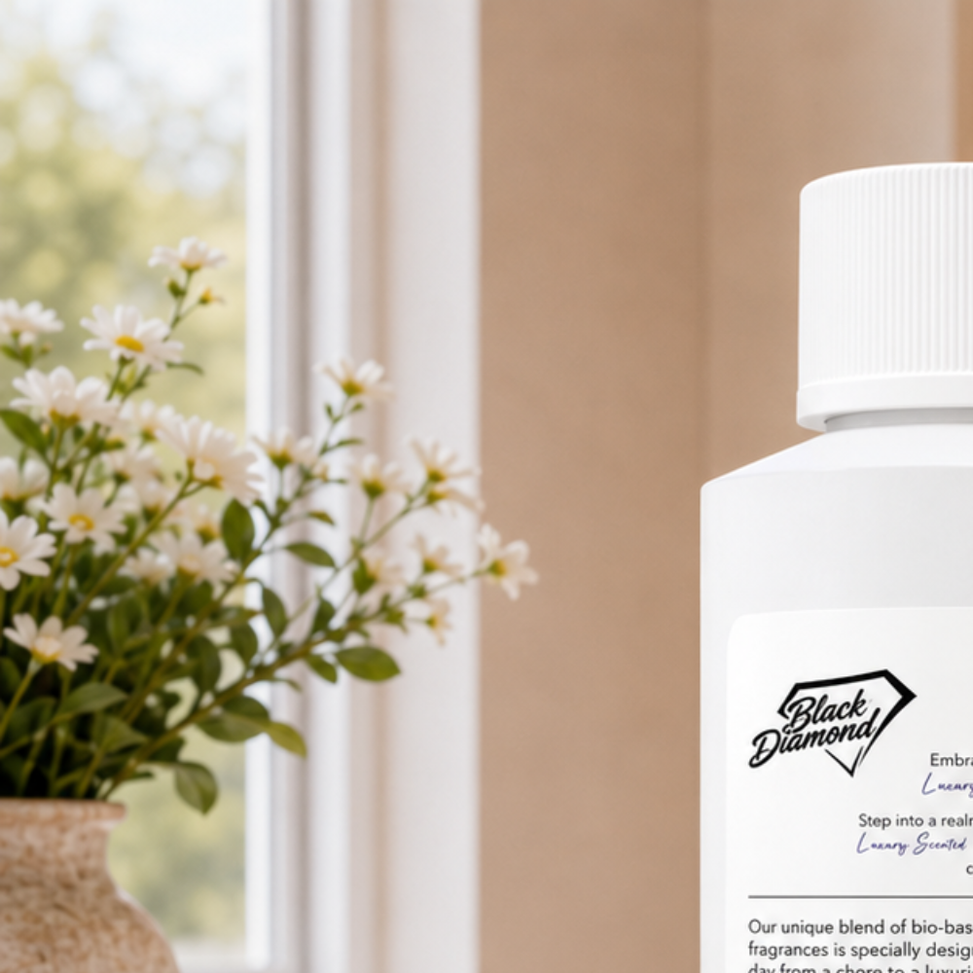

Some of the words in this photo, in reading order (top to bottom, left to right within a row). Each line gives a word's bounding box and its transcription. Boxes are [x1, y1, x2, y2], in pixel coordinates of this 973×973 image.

[782, 689, 867, 734] Black
[748, 707, 880, 768] Diamond
[859, 813, 892, 831] Step
[896, 814, 924, 827] into
[928, 817, 937, 827] a
[748, 918, 777, 934] Our
[781, 919, 834, 937] unique
[839, 919, 885, 935] blend
[890, 918, 907, 935] of
[748, 940, 829, 961] fragrances
[834, 942, 846, 957] is
[851, 941, 921, 961] specially
